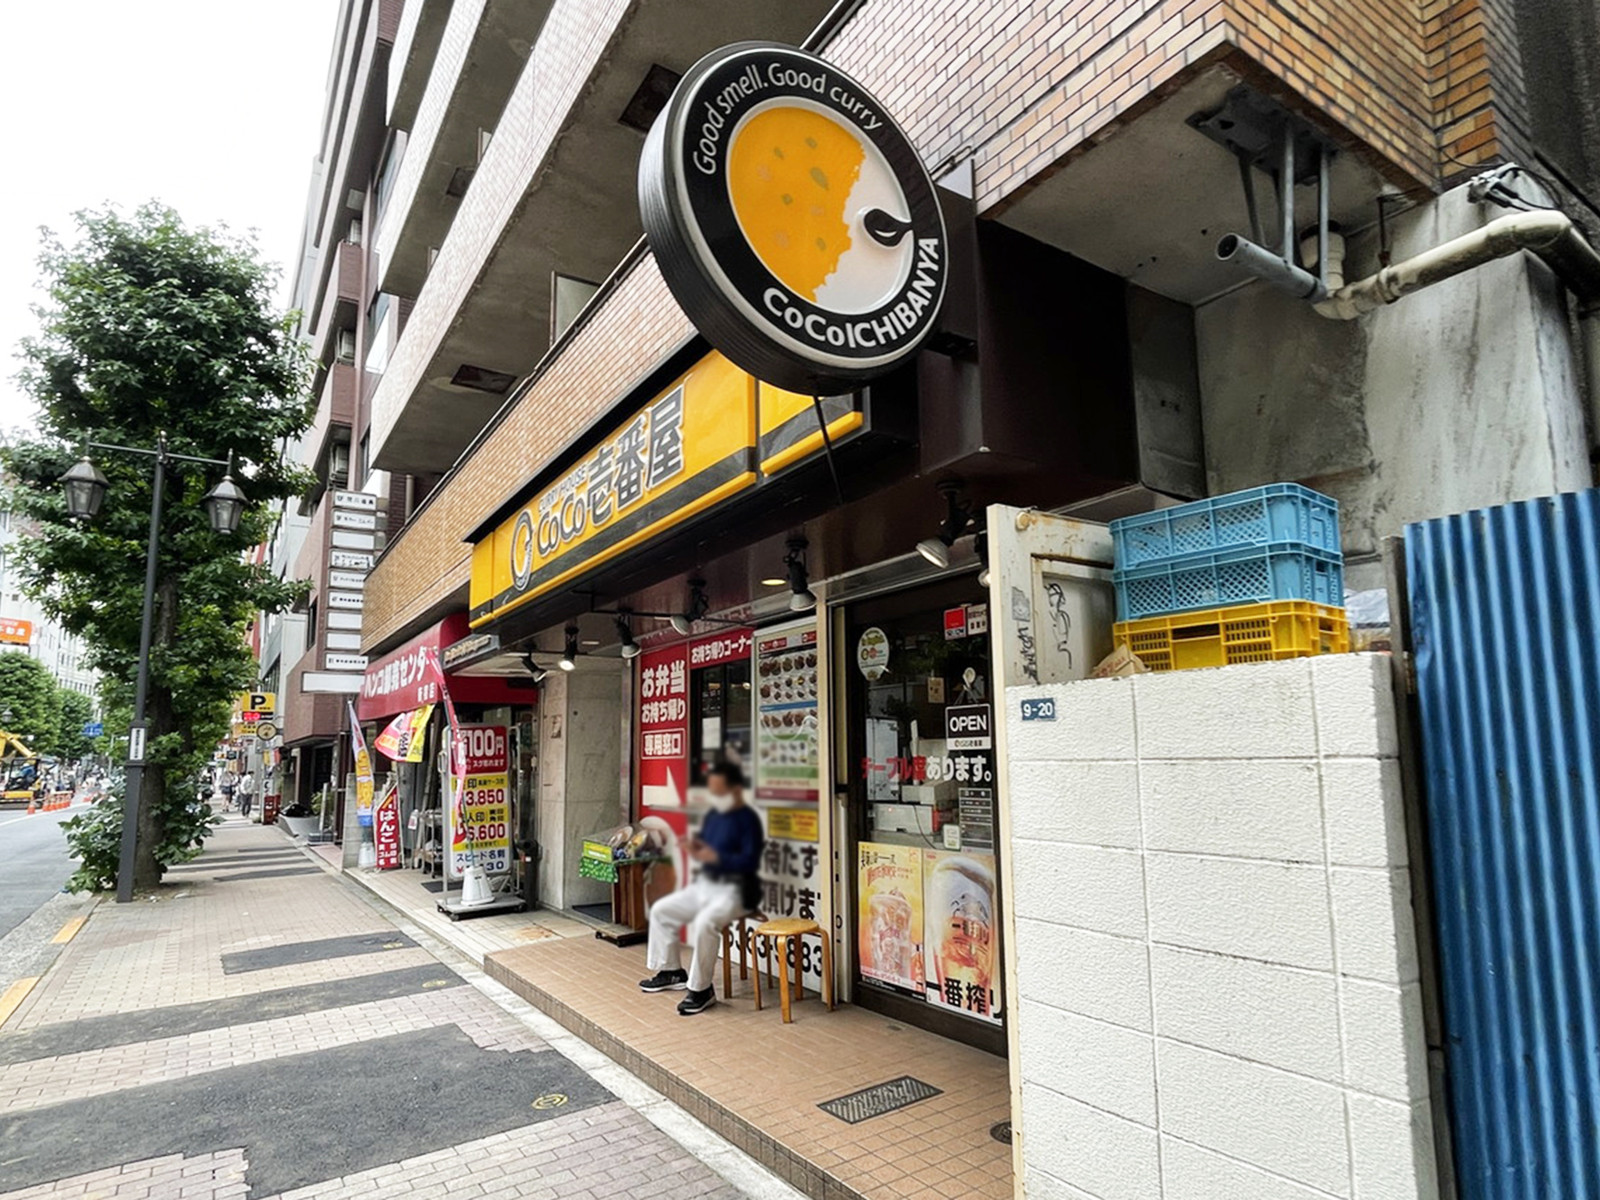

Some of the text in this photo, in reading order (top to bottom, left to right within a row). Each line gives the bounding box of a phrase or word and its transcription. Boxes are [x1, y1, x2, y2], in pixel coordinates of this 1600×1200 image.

[693, 62, 884, 175] Good smell. Good curry
[763, 238, 939, 348] CoCoICHIBANYA
[537, 383, 684, 558] CoCo壱番屋
[691, 634, 753, 664] お持ち帰りコーナー
[641, 660, 685, 698] お弁当
[250, 694, 267, 710] P
[641, 698, 686, 723] お持ち帰り
[1023, 702, 1054, 717] 9-20
[949, 714, 987, 732] OPEN
[644, 733, 681, 756] 専用窓口
[380, 810, 395, 843] はんこ
